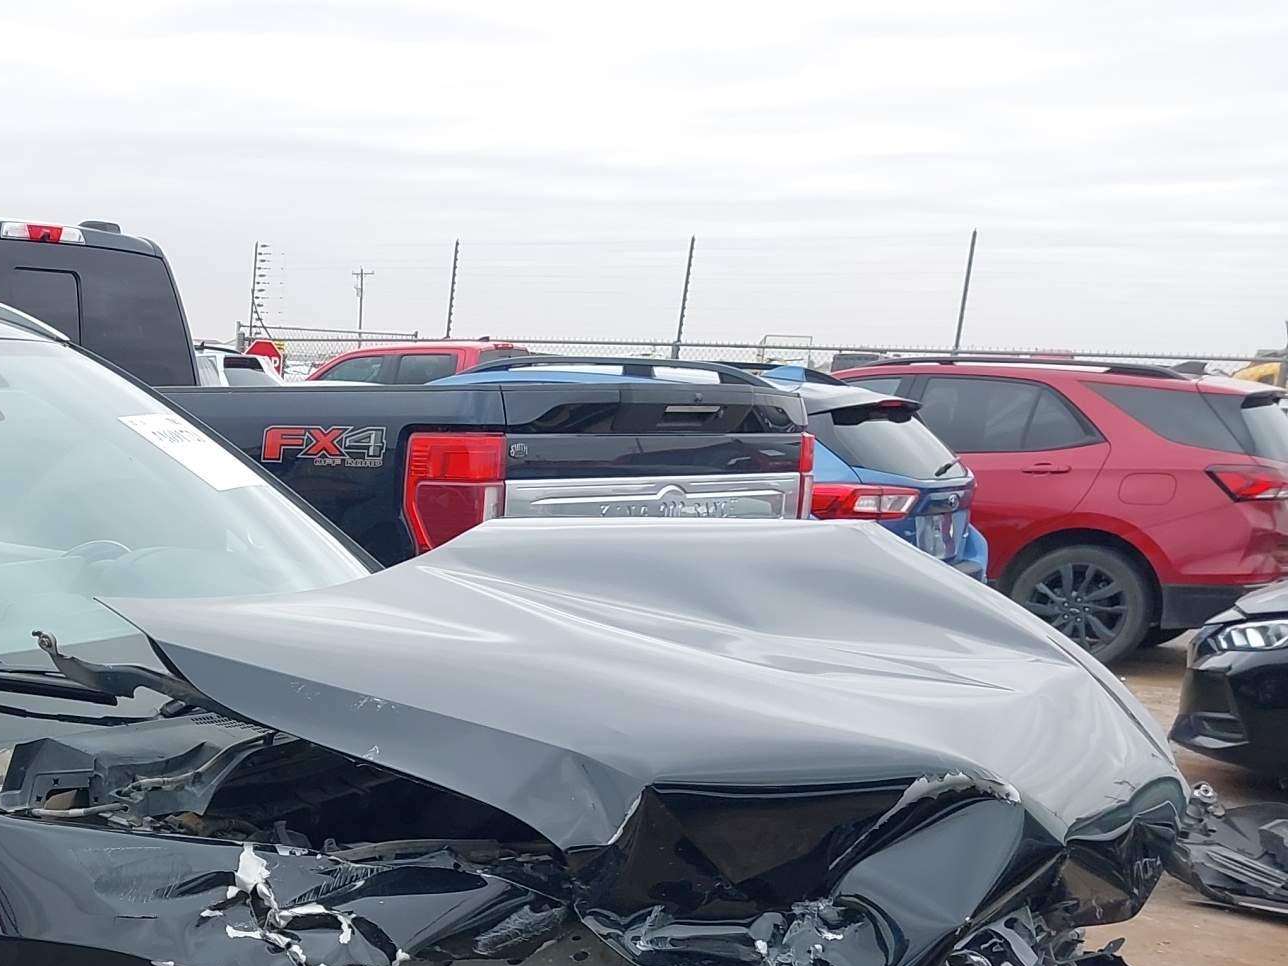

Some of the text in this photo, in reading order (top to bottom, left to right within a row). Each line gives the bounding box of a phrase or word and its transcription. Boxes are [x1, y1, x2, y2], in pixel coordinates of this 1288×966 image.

[261, 425, 386, 463] FX4
[313, 458, 383, 467] OFF ROAD
